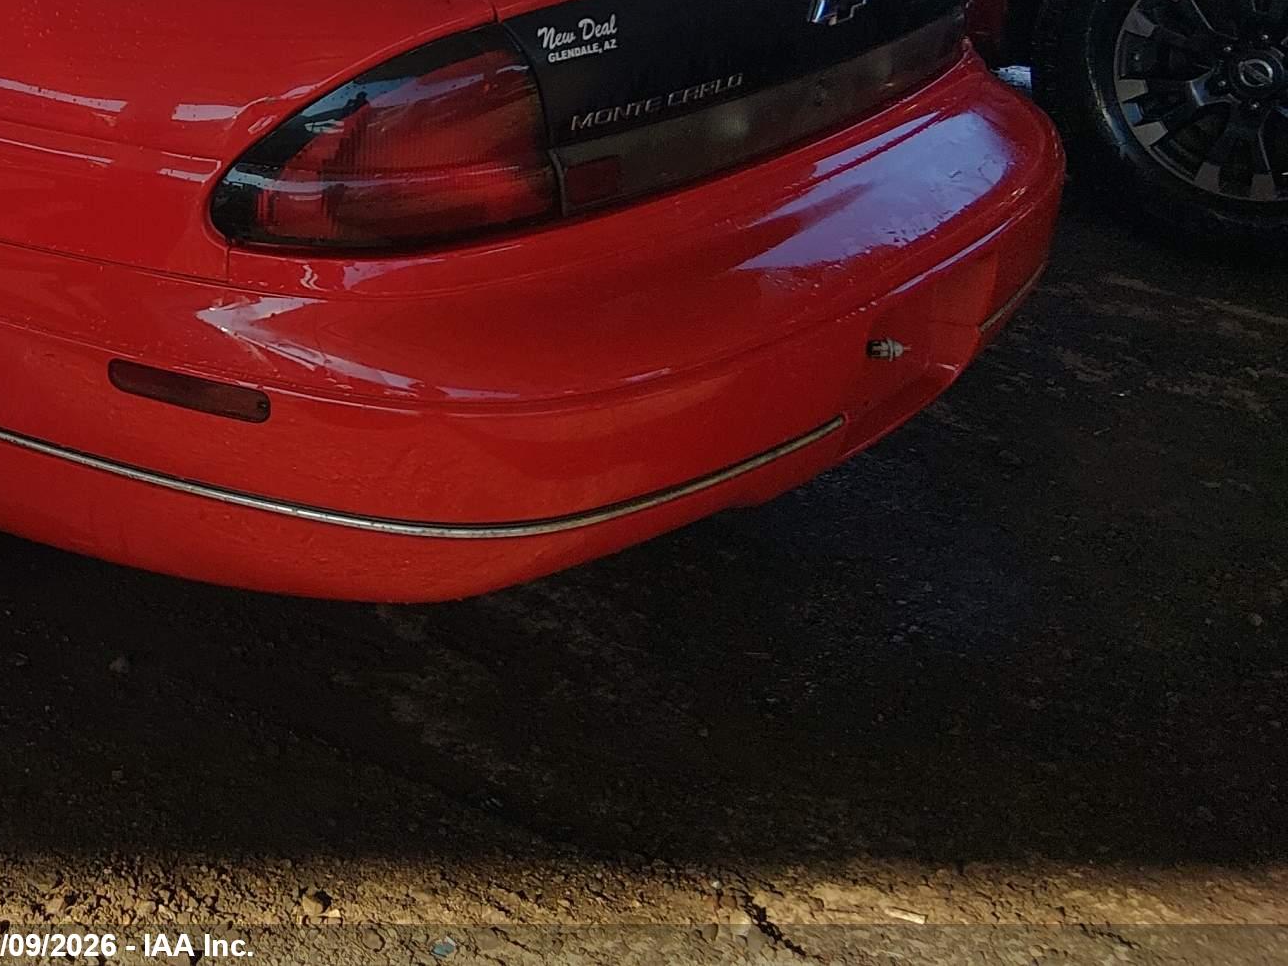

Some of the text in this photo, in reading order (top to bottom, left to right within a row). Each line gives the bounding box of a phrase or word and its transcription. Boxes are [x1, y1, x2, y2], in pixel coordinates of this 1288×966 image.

[537, 13, 618, 50] New Deal
[547, 38, 619, 63] GLENDALE, AZ
[569, 72, 745, 131] MONTE CARLO
